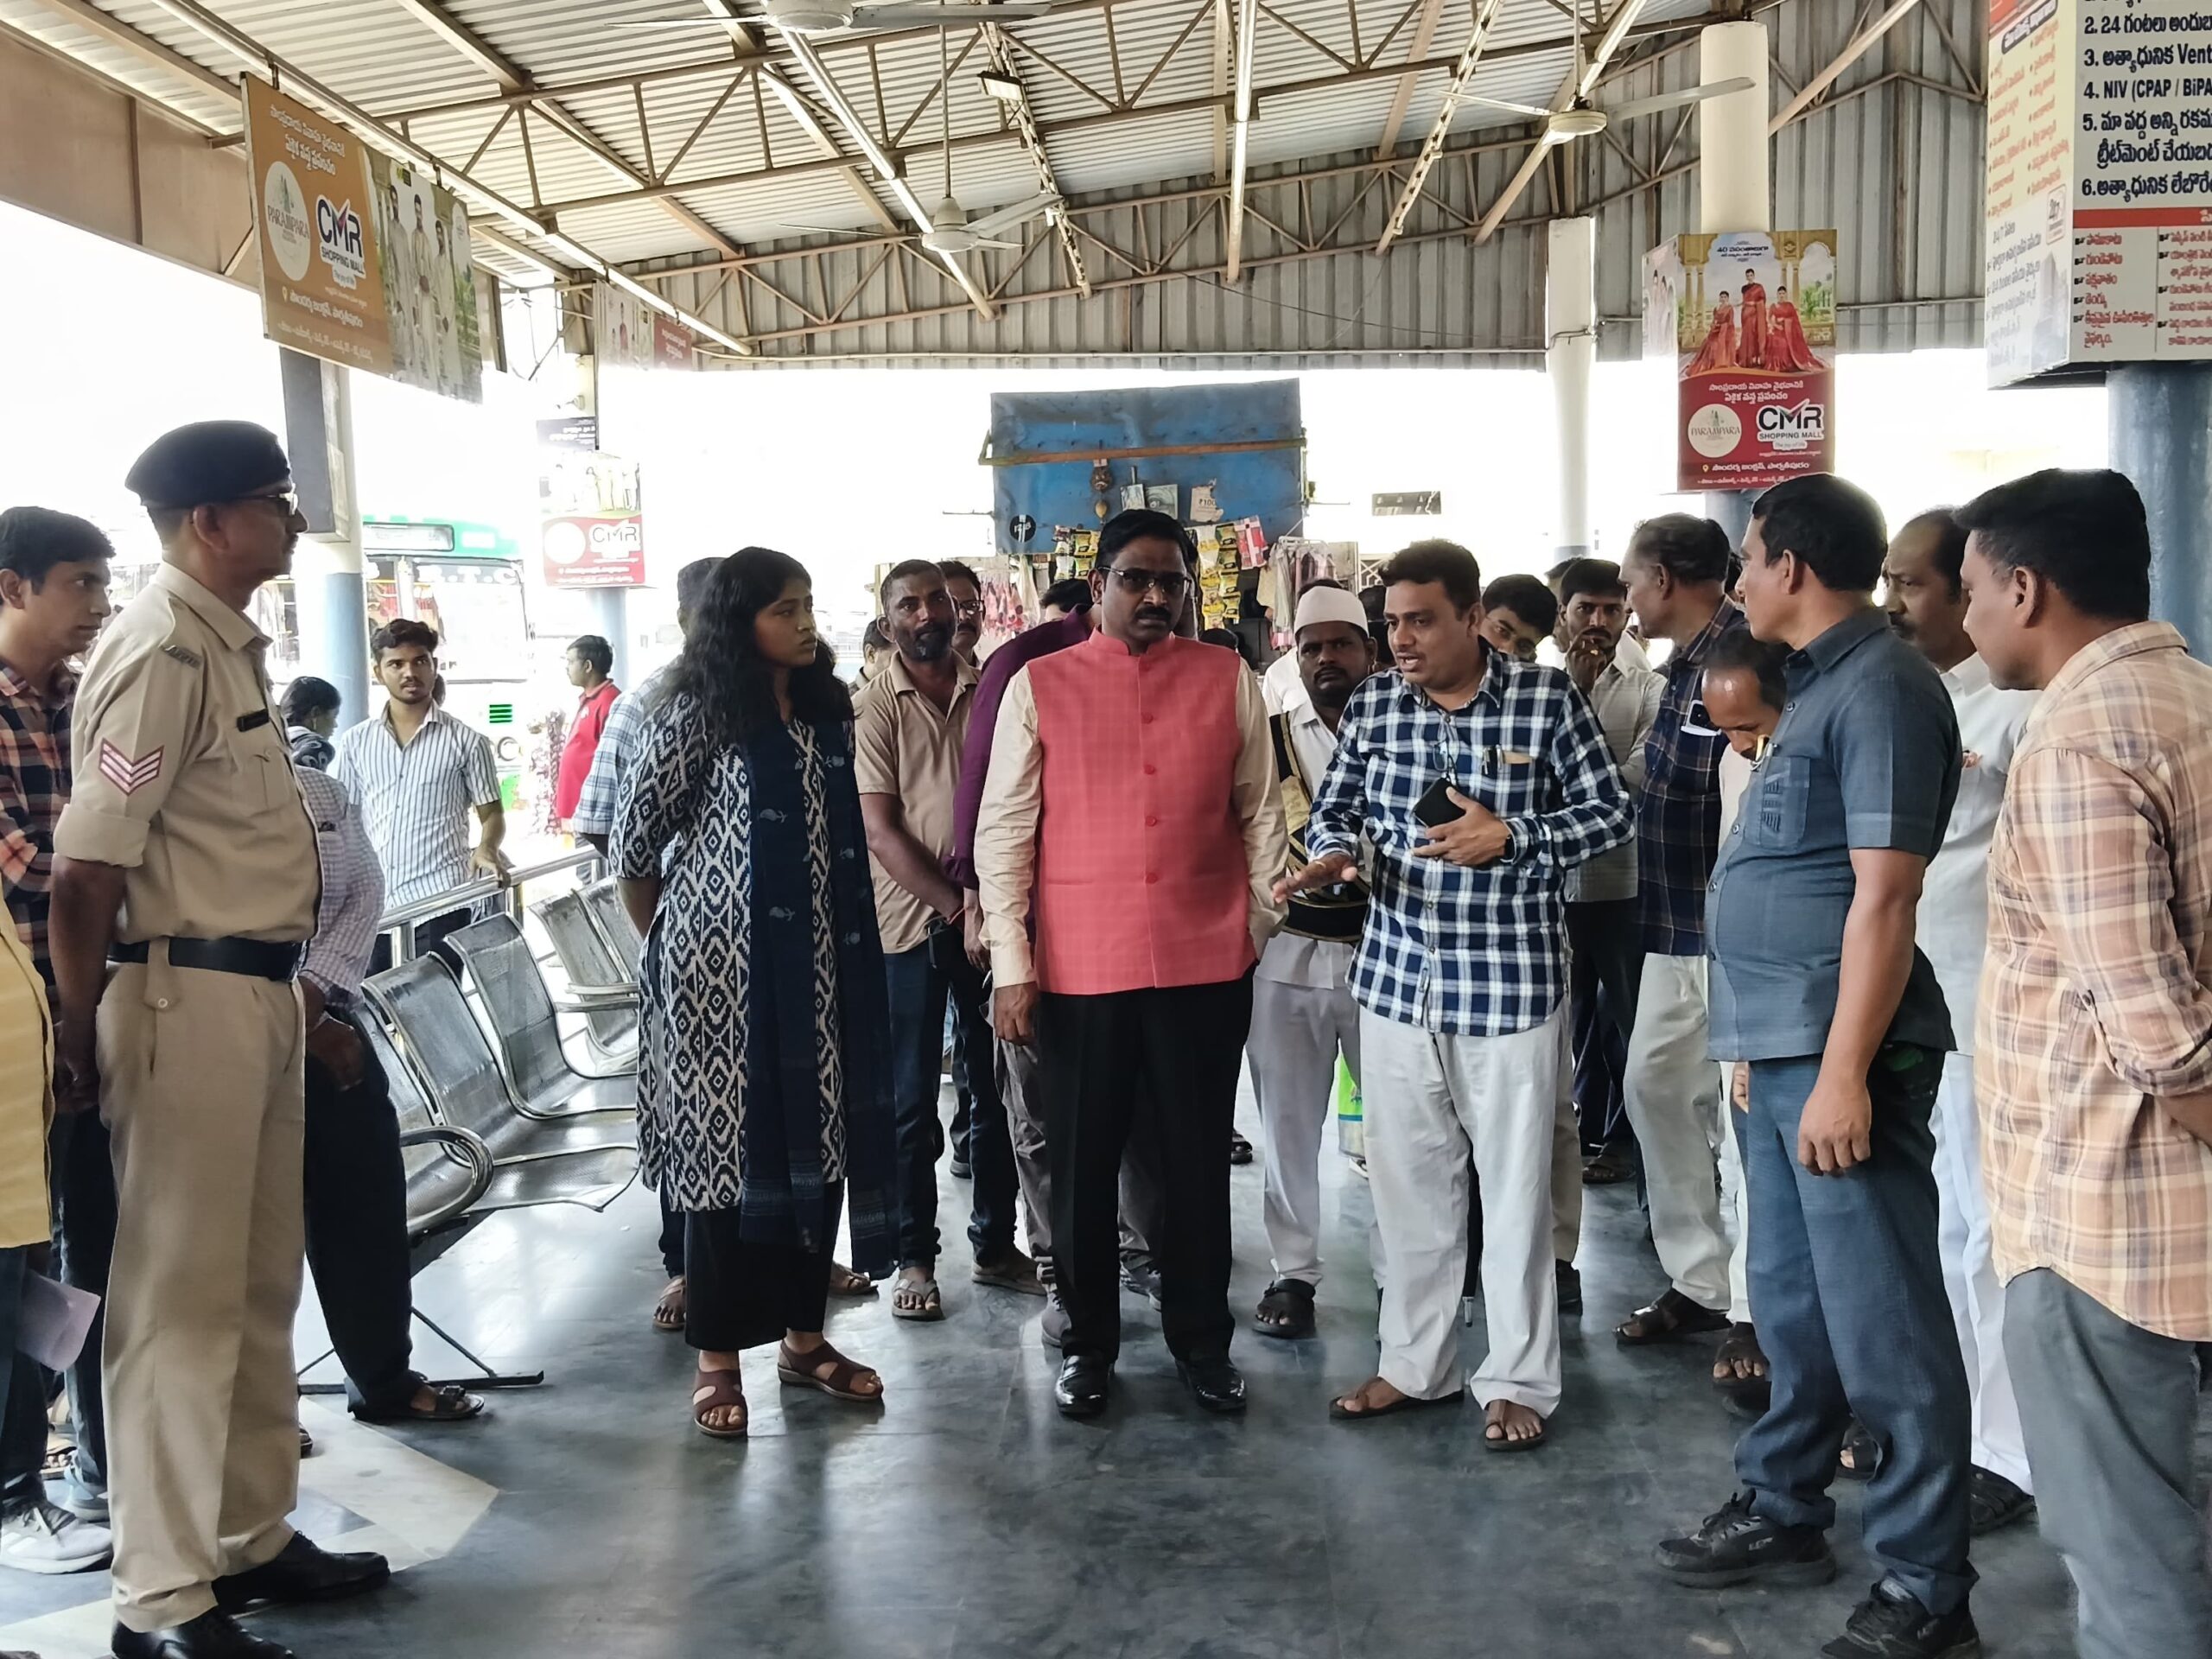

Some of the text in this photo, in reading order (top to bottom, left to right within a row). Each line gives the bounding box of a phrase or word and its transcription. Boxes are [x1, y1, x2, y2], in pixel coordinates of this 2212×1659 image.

[2084, 16, 2098, 34] 2.
[2101, 16, 2120, 34] 24
[2124, 13, 2166, 33] గంటలు
[2083, 43, 2212, 73] 3. అత్యాధునిక Vent
[2083, 78, 2212, 103] 4. NIV (CPAP / BiPA
[2082, 113, 2097, 131] 5.
[2101, 111, 2122, 130] మా
[2124, 111, 2147, 140] వద్ద
[2150, 111, 2178, 136] అన్ని
[267, 205, 310, 239] PARAMPARA
[317, 199, 363, 258] CMR
[321, 246, 365, 275] SHOPPING MALL
[1758, 402, 1821, 430] CMR
[1691, 426, 1740, 436] PARAMPARA
[593, 526, 637, 543] CMR
